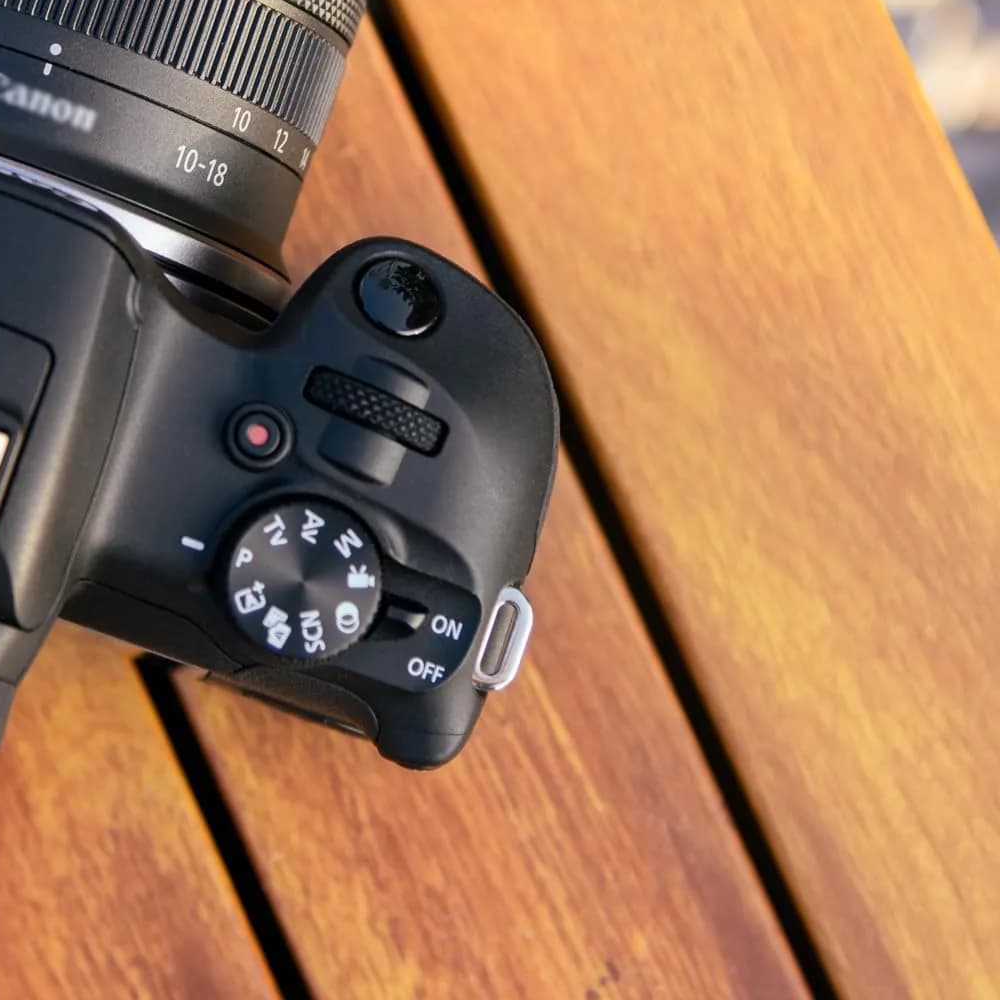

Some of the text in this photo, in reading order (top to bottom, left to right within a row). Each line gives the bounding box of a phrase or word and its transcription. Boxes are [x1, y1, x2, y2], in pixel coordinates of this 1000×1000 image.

[232, 107, 289, 154] 10 12
[175, 144, 229, 187] 10-18
[263, 514, 288, 546] Tv
[300, 509, 325, 544] Av
[235, 547, 253, 568] P
[333, 528, 363, 559] M
[299, 609, 326, 653] SCN
[431, 615, 463, 641] ON
[407, 657, 445, 684] OFF
